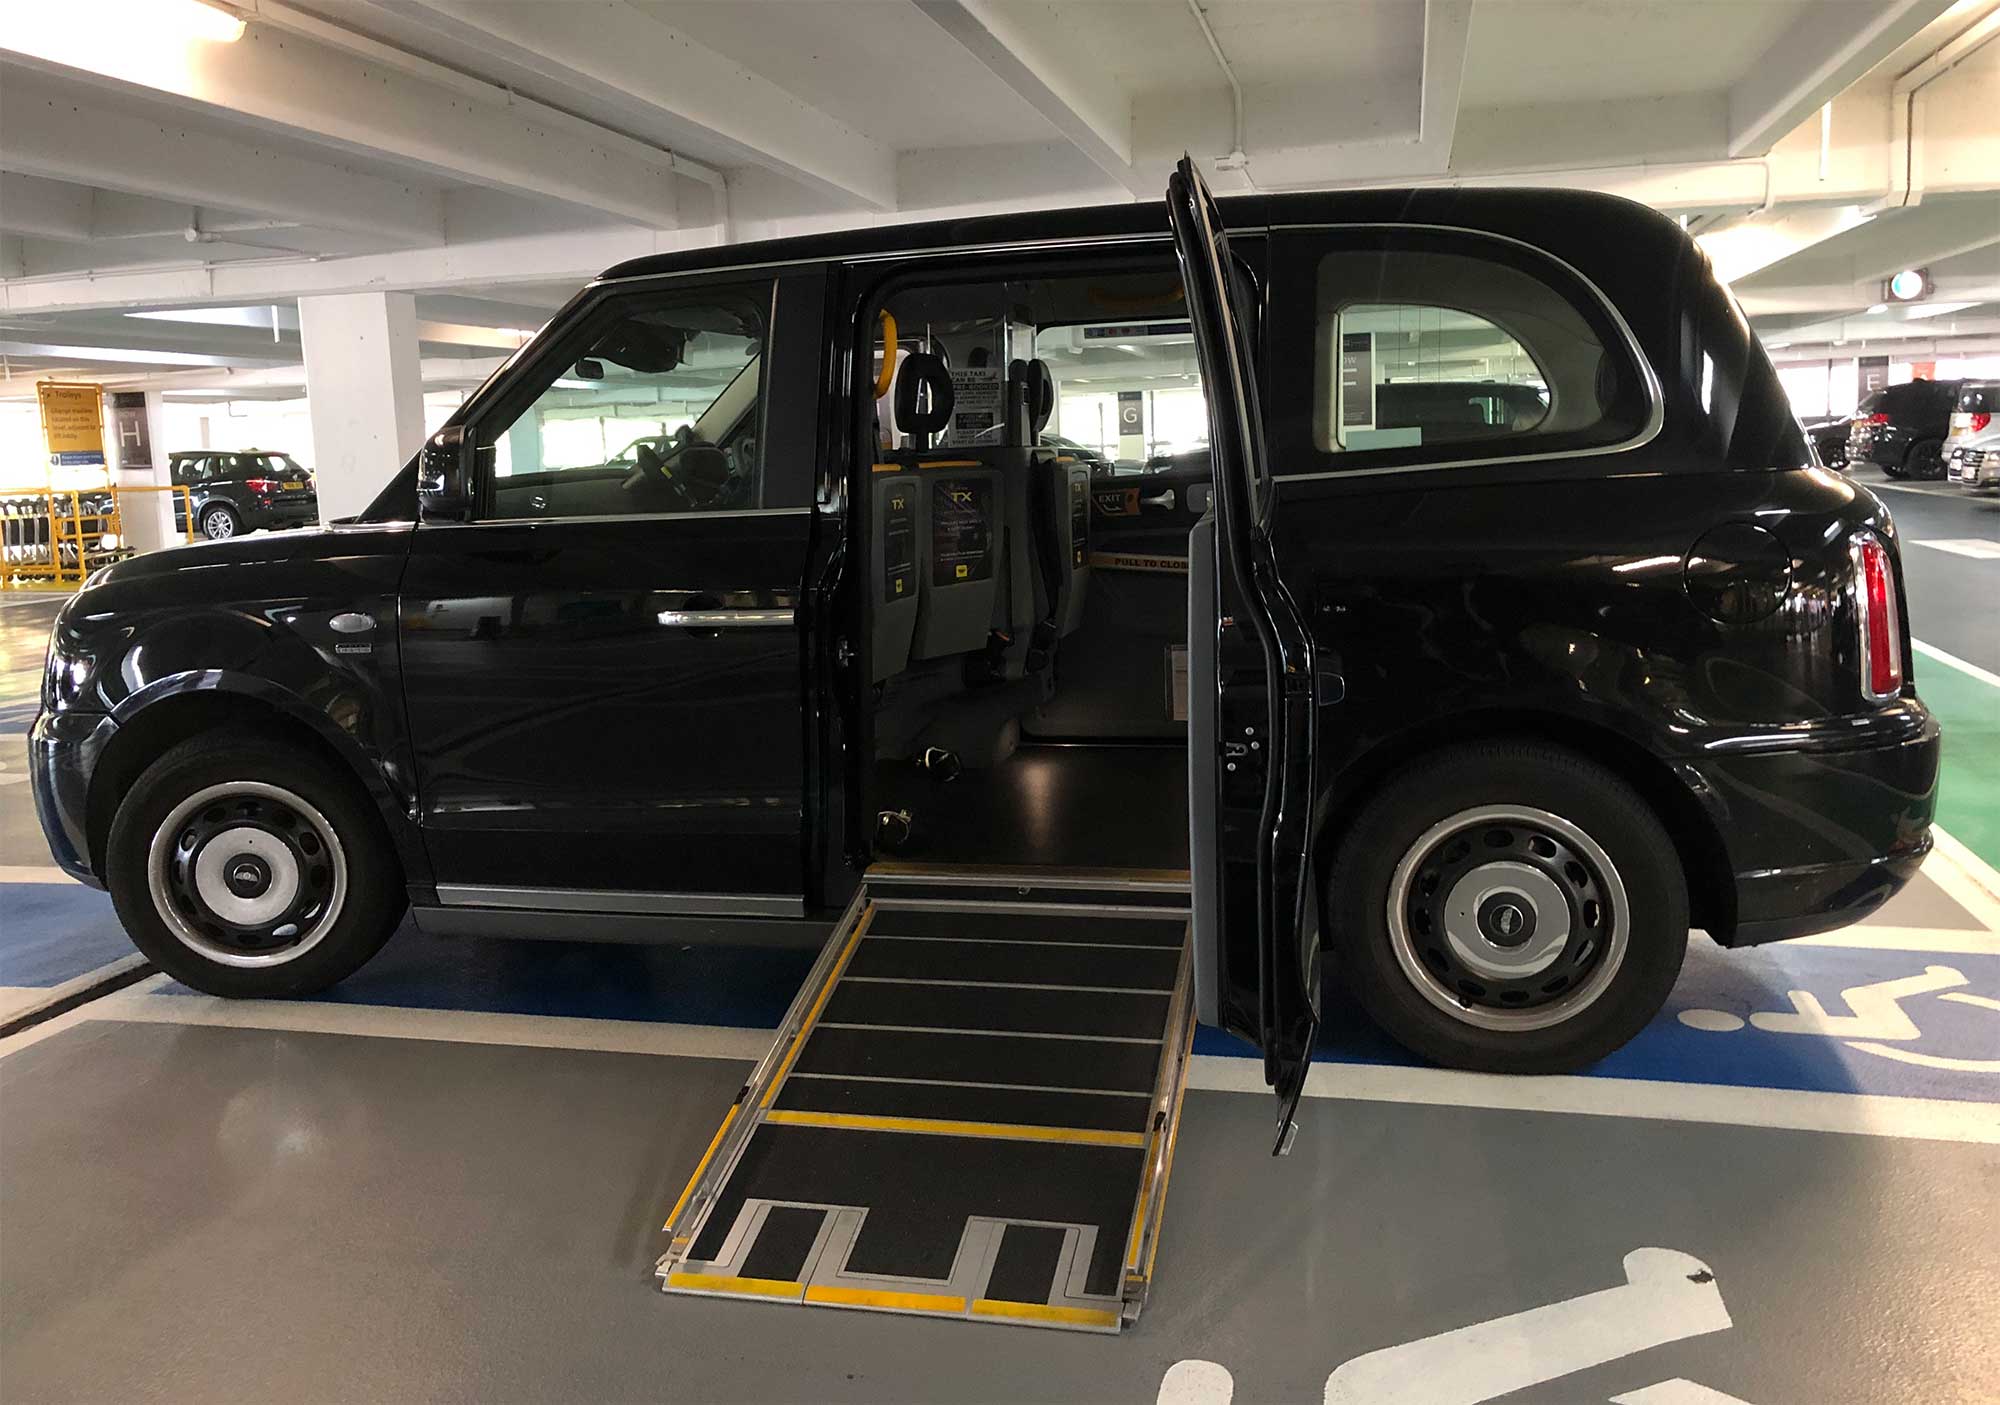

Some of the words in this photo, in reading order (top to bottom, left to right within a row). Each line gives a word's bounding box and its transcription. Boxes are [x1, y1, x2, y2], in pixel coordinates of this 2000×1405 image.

[1123, 407, 1138, 424] G
[119, 421, 141, 447] H
[951, 491, 973, 502] TX
[1098, 493, 1121, 503] EXIT
[891, 499, 905, 510] TX
[1114, 558, 1140, 567] PULL
[1143, 559, 1157, 568] TO
[1160, 560, 1188, 569] CLOS
